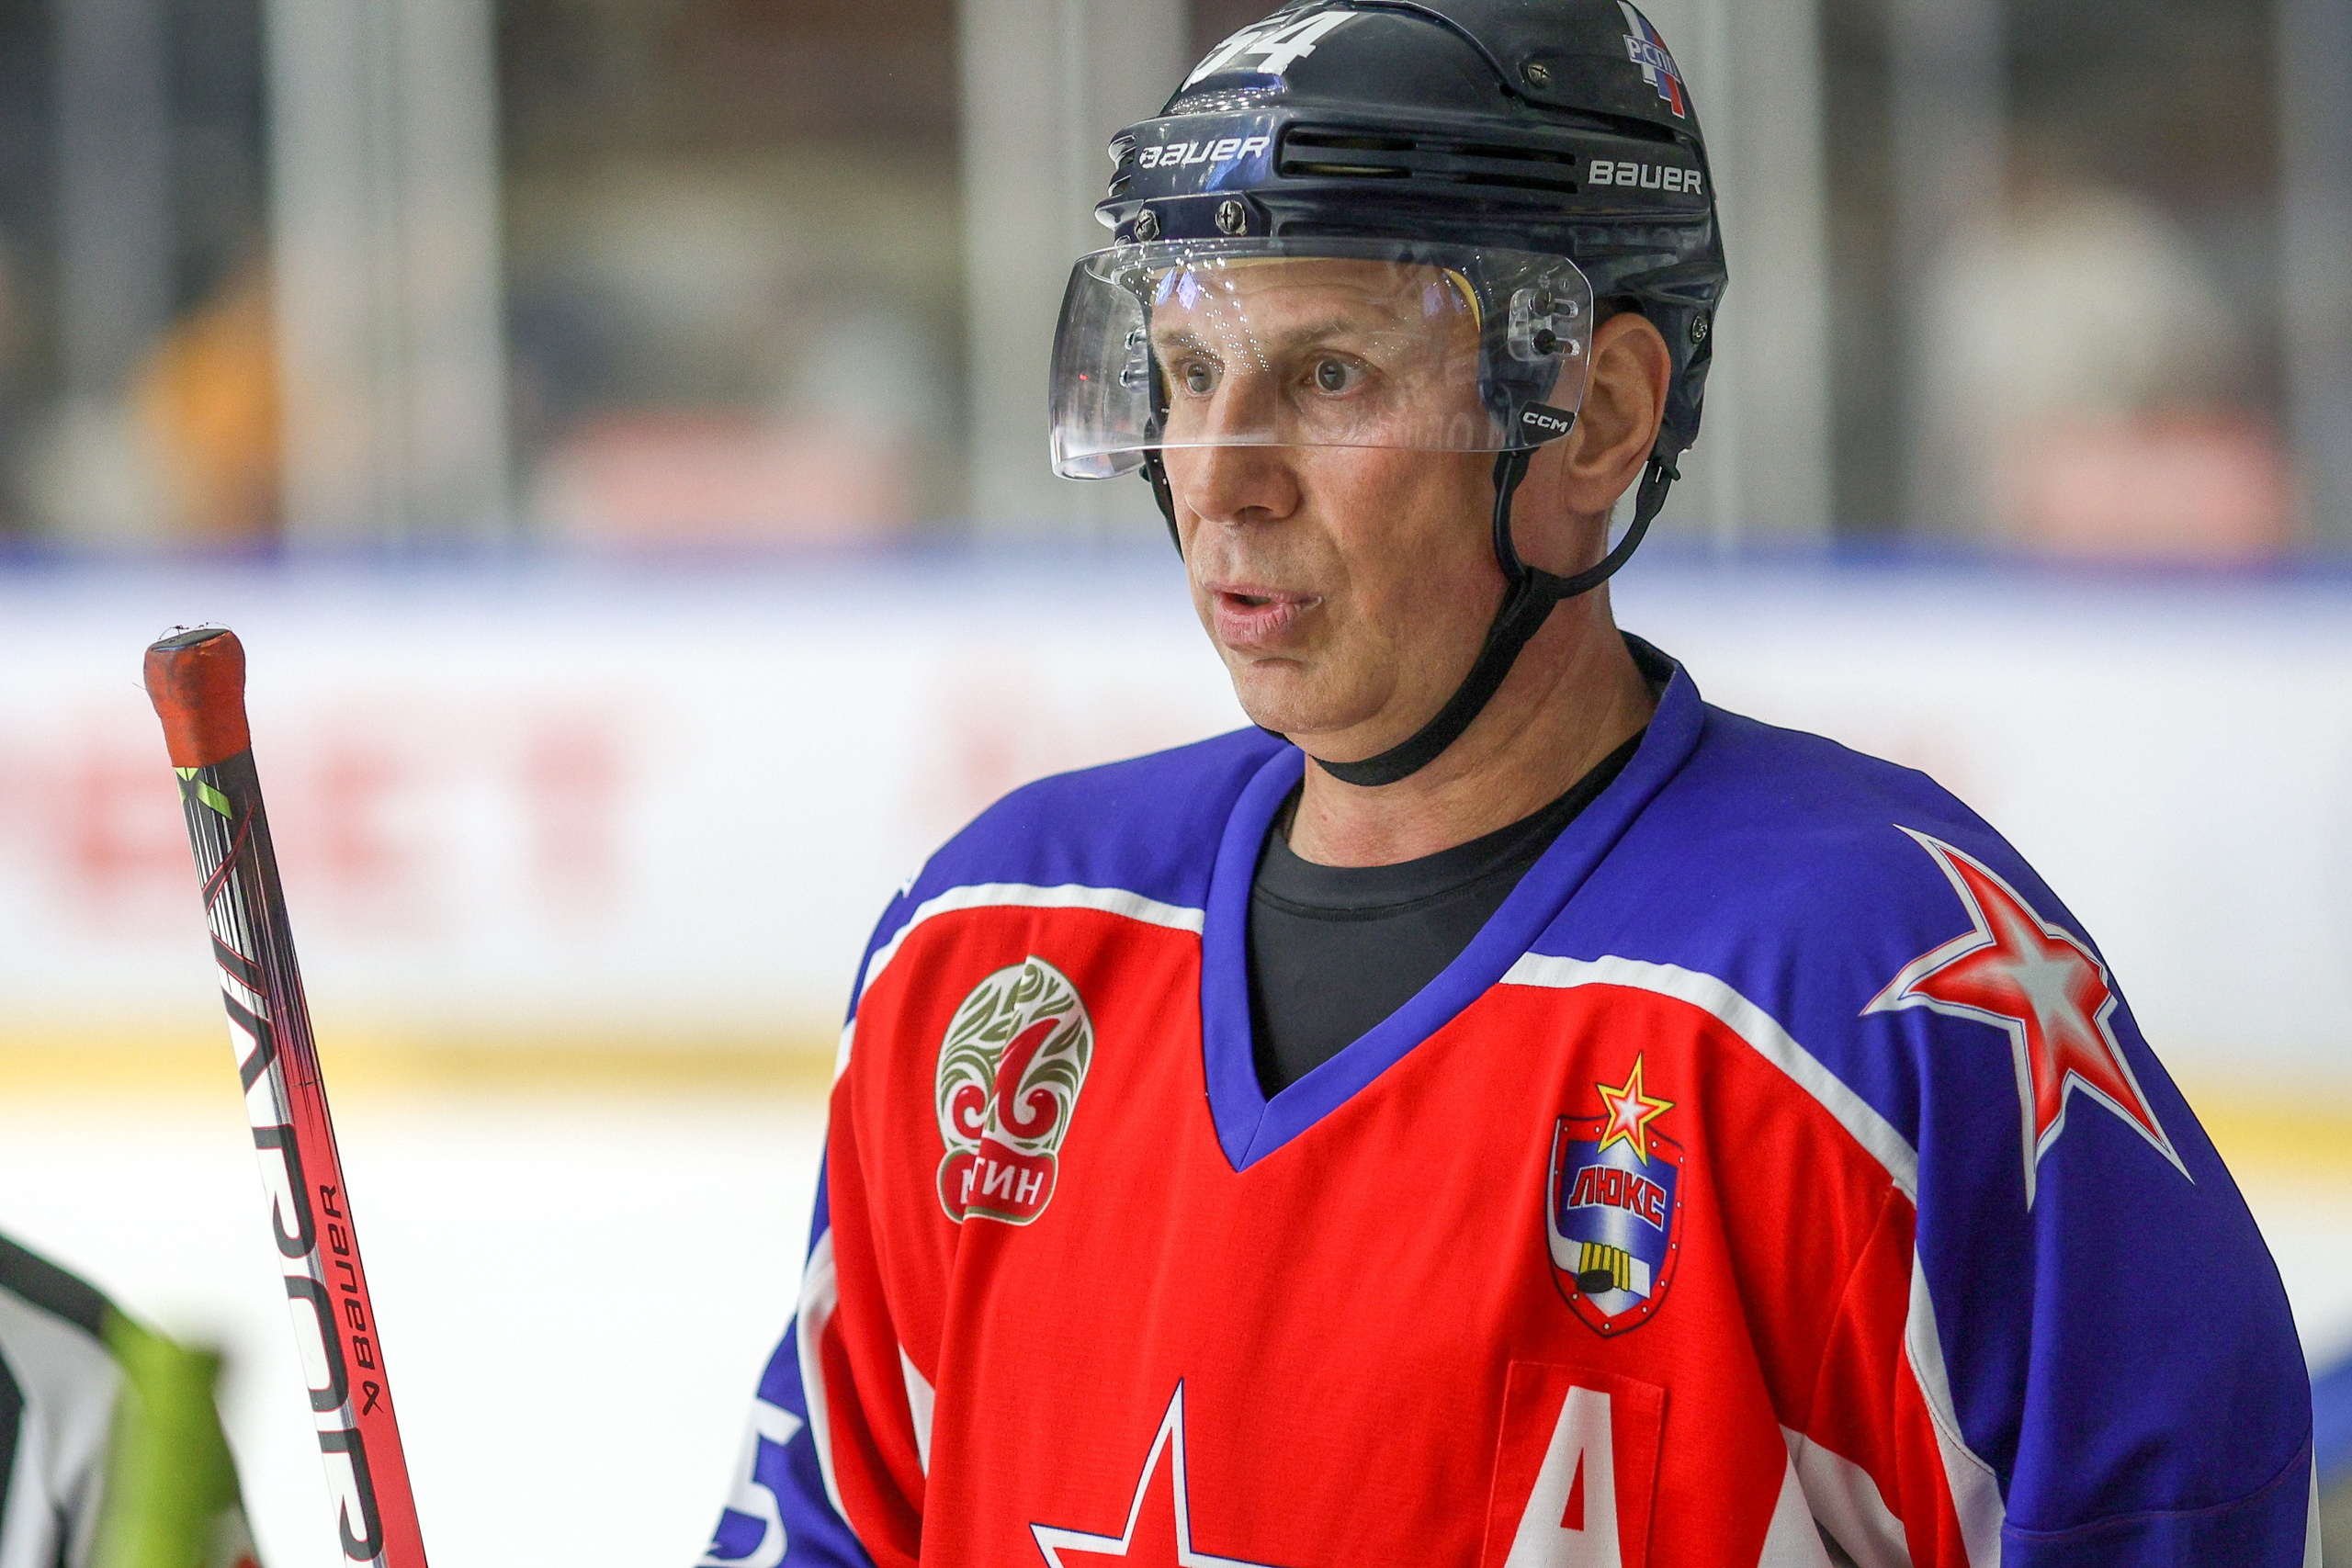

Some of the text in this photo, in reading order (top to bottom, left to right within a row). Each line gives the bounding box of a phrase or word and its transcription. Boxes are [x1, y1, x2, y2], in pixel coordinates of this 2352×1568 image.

[1588, 160, 1702, 195] BAUER
[1521, 412, 1569, 433] CCM
[1567, 1164, 1667, 1232] ЛЮКС
[320, 1184, 376, 1371] BAUER
[1504, 1384, 1623, 1568] A
